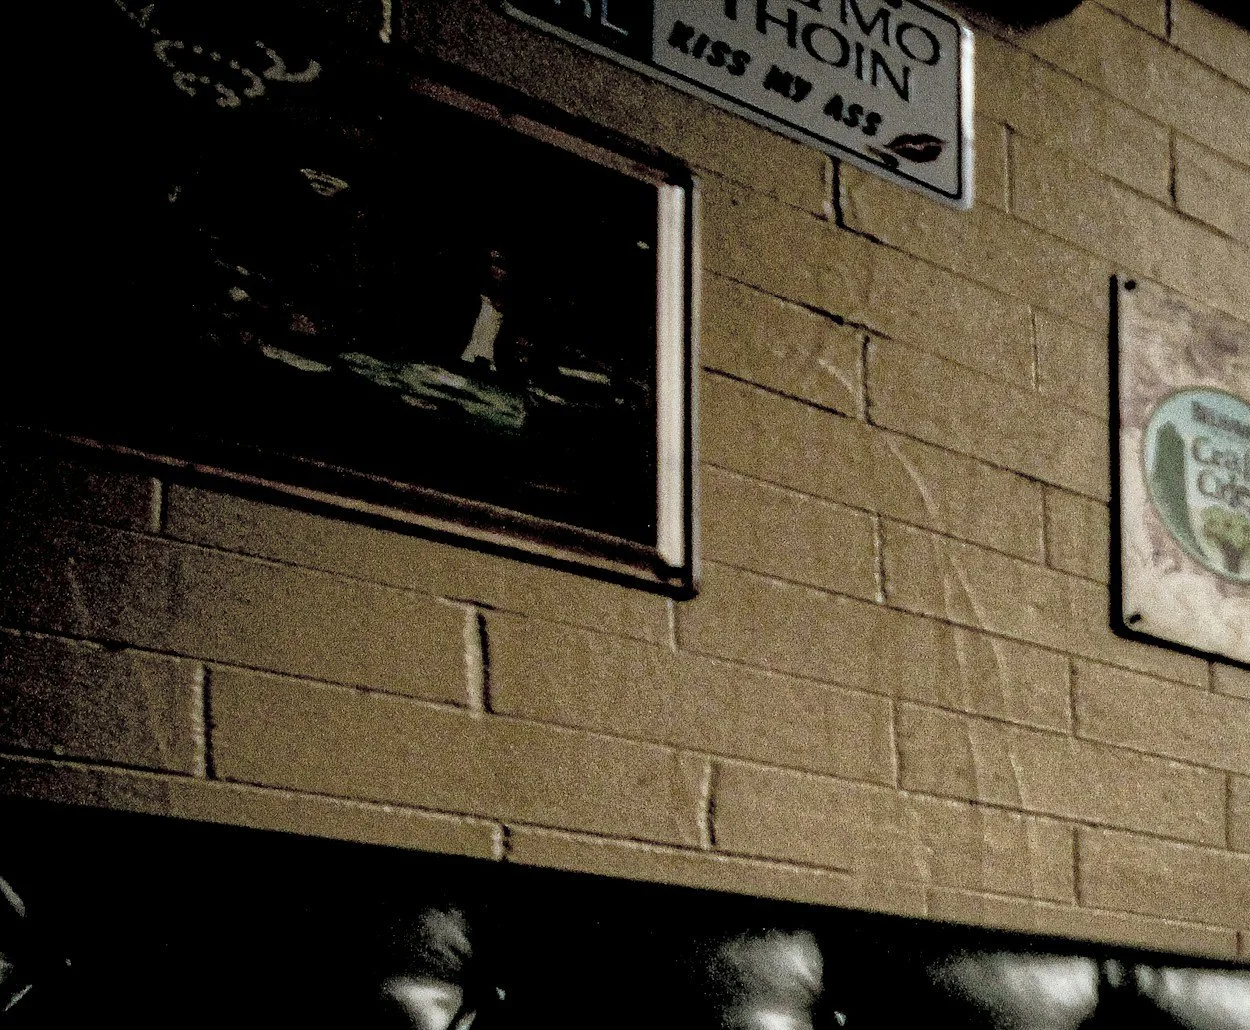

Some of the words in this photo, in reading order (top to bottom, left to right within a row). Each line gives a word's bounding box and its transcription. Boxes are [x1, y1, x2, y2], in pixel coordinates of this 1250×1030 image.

[667, 20, 750, 76] KISS
[763, 65, 812, 102] MY
[824, 95, 882, 136] ASS
